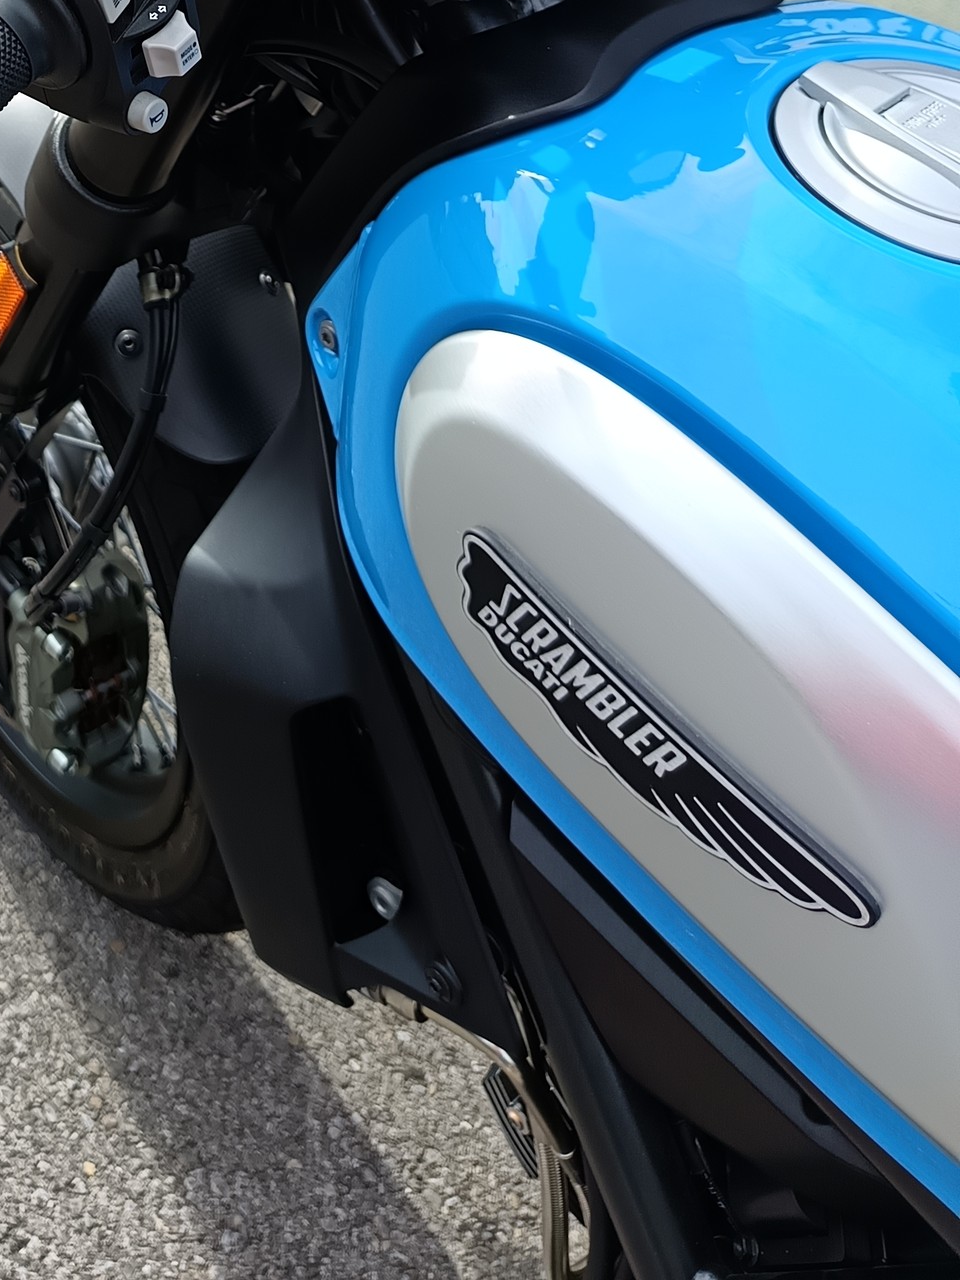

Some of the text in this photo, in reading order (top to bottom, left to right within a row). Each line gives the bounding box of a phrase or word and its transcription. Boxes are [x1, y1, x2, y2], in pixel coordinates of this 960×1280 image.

[180, 45, 193, 59] MODE
[182, 51, 195, 66] ENTER
[477, 605, 571, 702] DUCATI
[489, 584, 688, 778] SCRAMBLER
